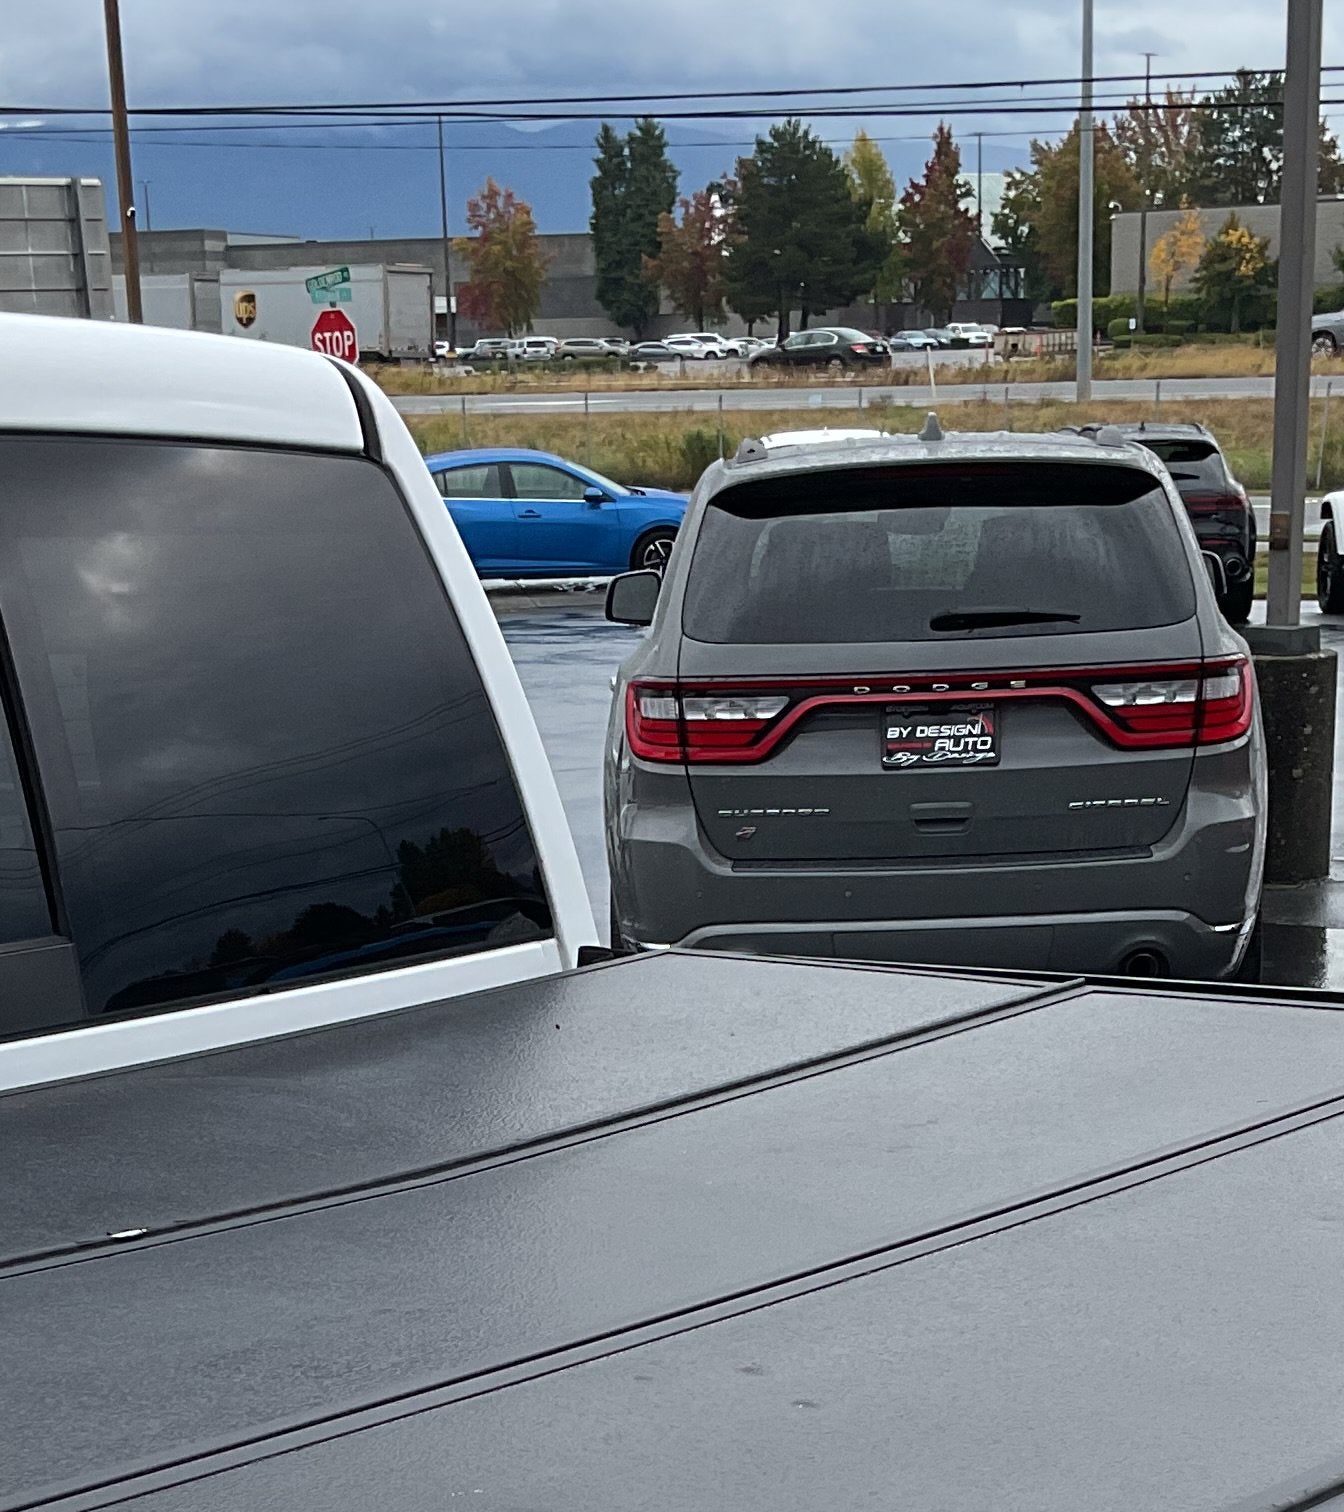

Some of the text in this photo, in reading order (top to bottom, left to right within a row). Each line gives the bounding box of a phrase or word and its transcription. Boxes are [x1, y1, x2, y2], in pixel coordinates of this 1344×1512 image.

[314, 331, 354, 357] STOP
[853, 680, 1027, 695] DODGE
[887, 723, 981, 739] BY DESIGN
[934, 736, 992, 752] AUTO
